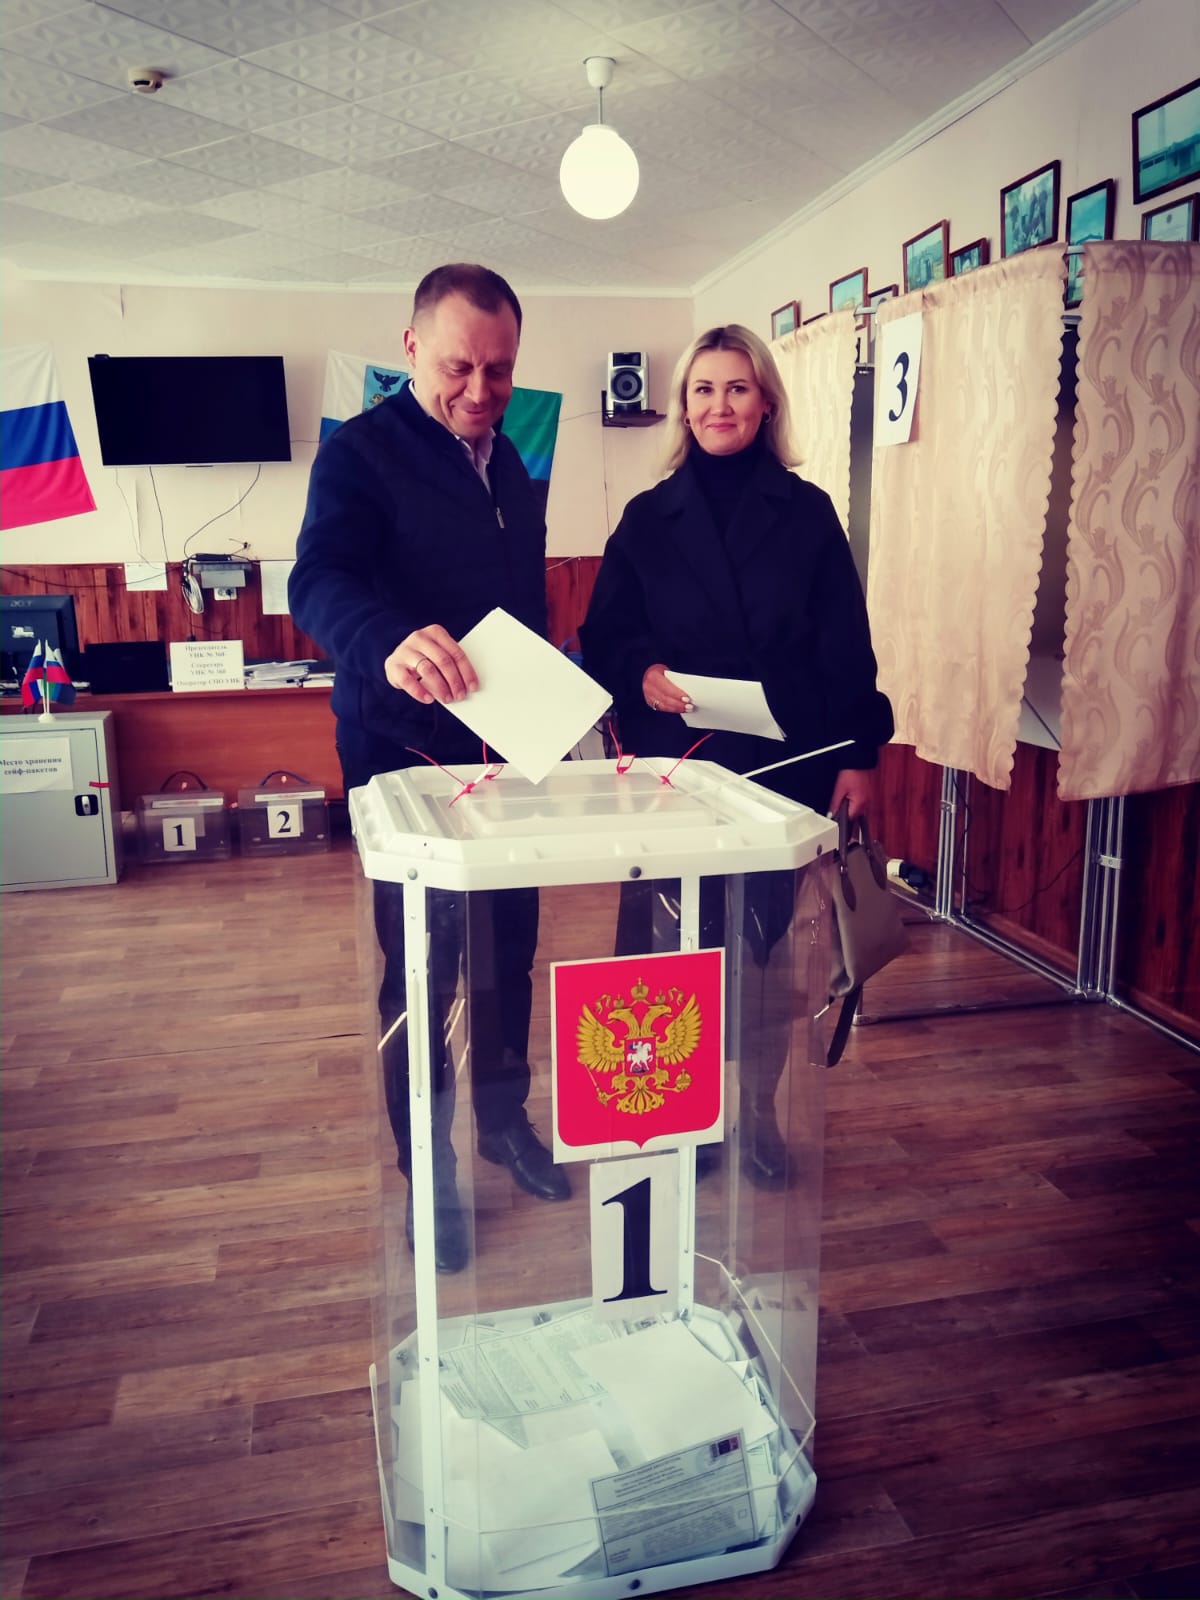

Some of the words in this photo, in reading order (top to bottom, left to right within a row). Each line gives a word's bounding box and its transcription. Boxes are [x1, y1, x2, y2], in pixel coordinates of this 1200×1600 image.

[888, 351, 910, 422] 3
[172, 823, 185, 847] 1
[276, 810, 292, 833] 2
[601, 1176, 668, 1303] 1
